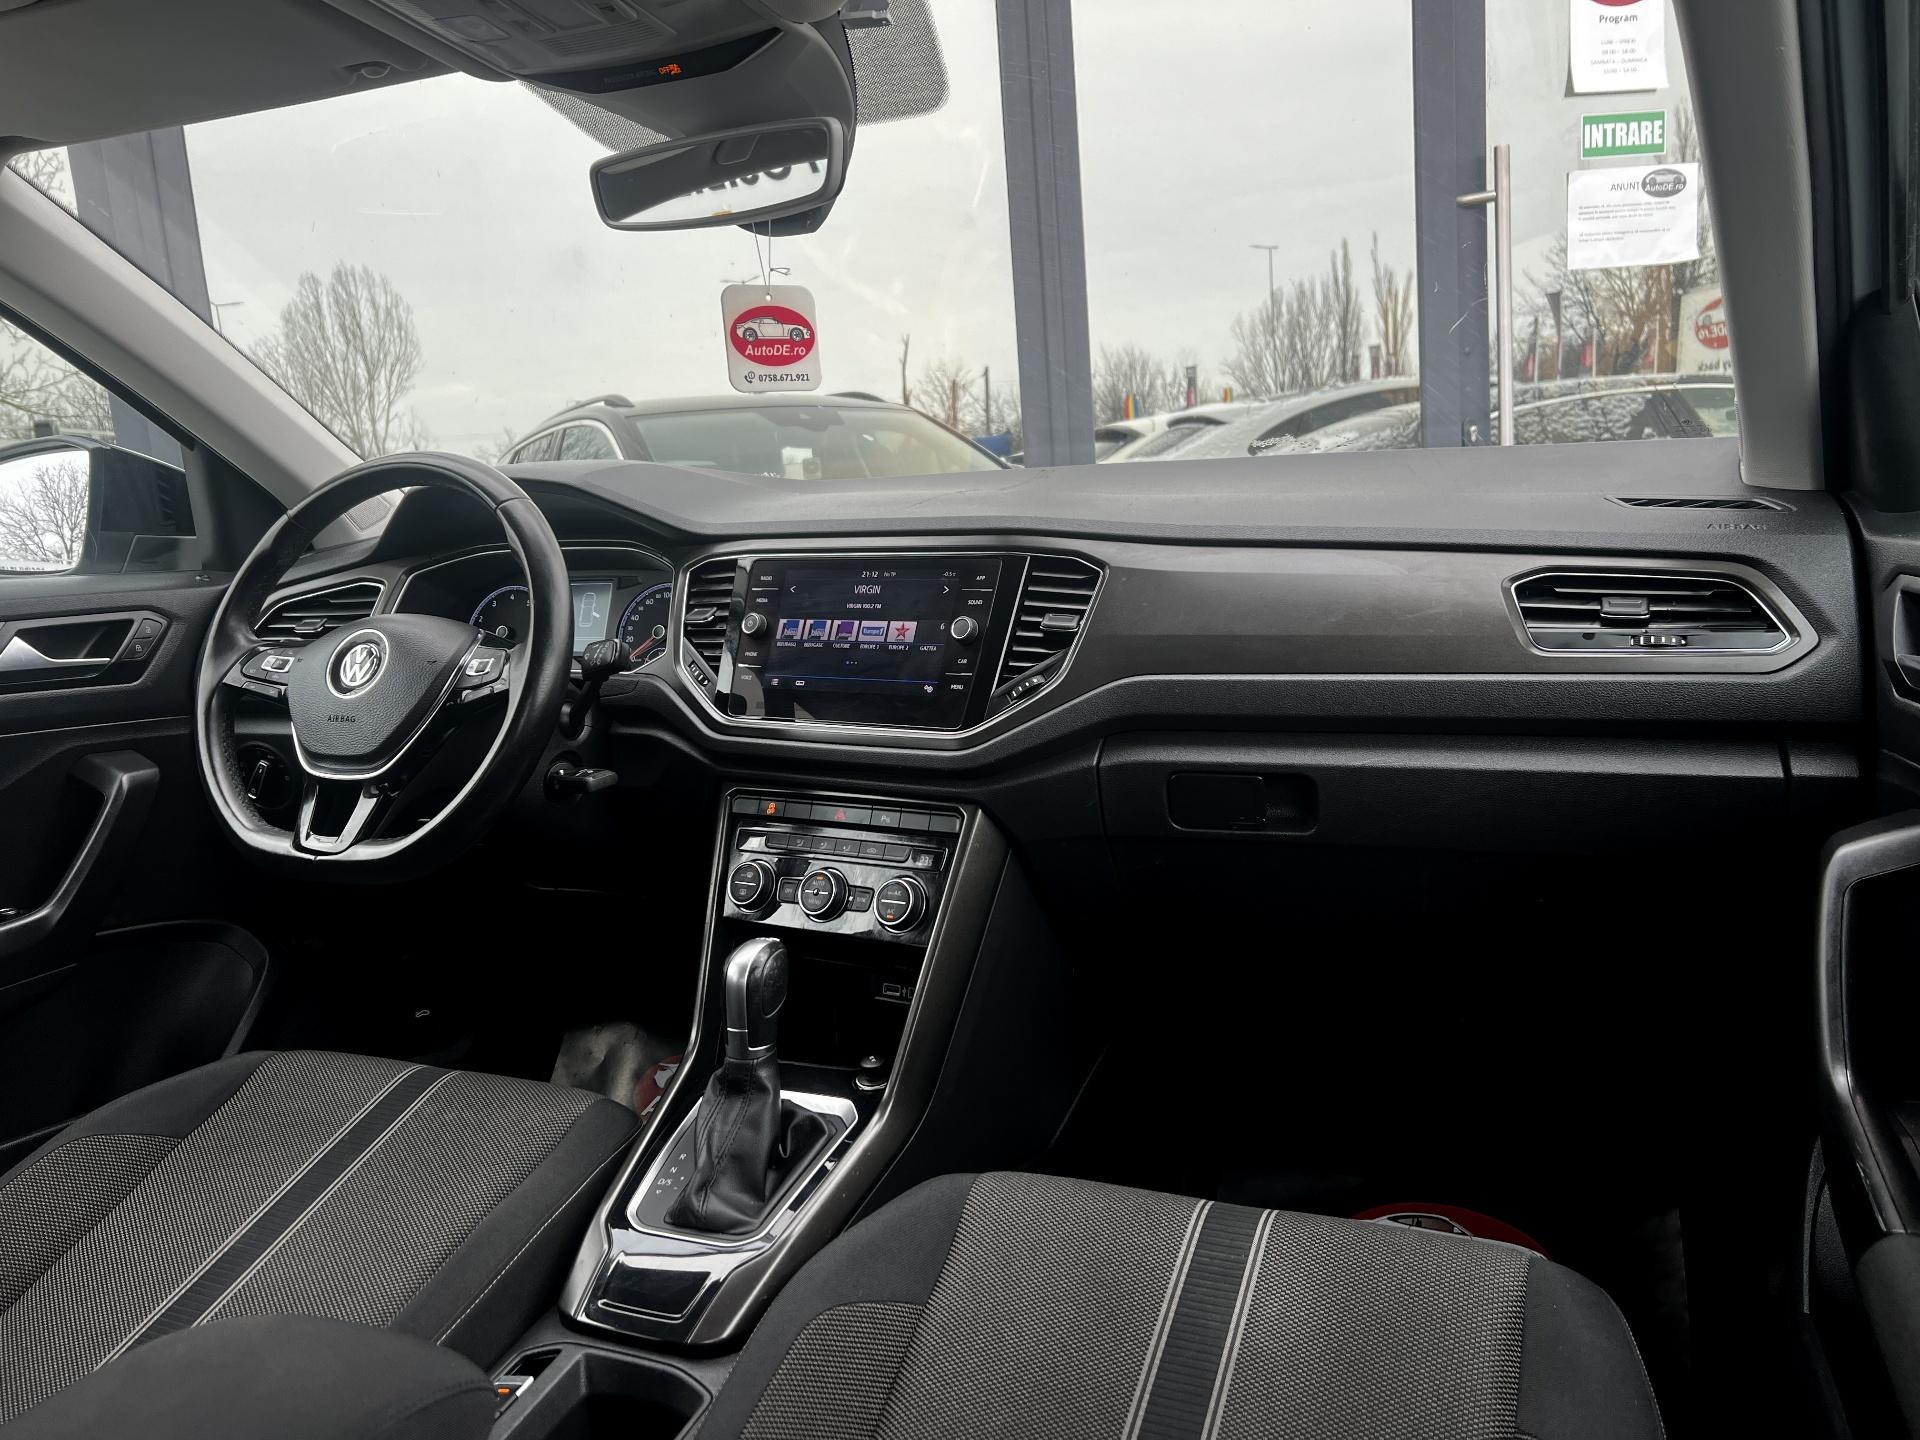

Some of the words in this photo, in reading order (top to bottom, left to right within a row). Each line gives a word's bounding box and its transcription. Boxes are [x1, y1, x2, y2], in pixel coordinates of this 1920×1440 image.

[1600, 15, 1638, 24] Program
[1584, 119, 1663, 149] INTRARE
[1644, 182, 1684, 192] AutoDE.ro
[745, 344, 806, 356] AutoDE.ro
[758, 373, 810, 383] 0758.671.921
[854, 585, 881, 594] VIRGIN
[327, 715, 356, 723] AIRBAG
